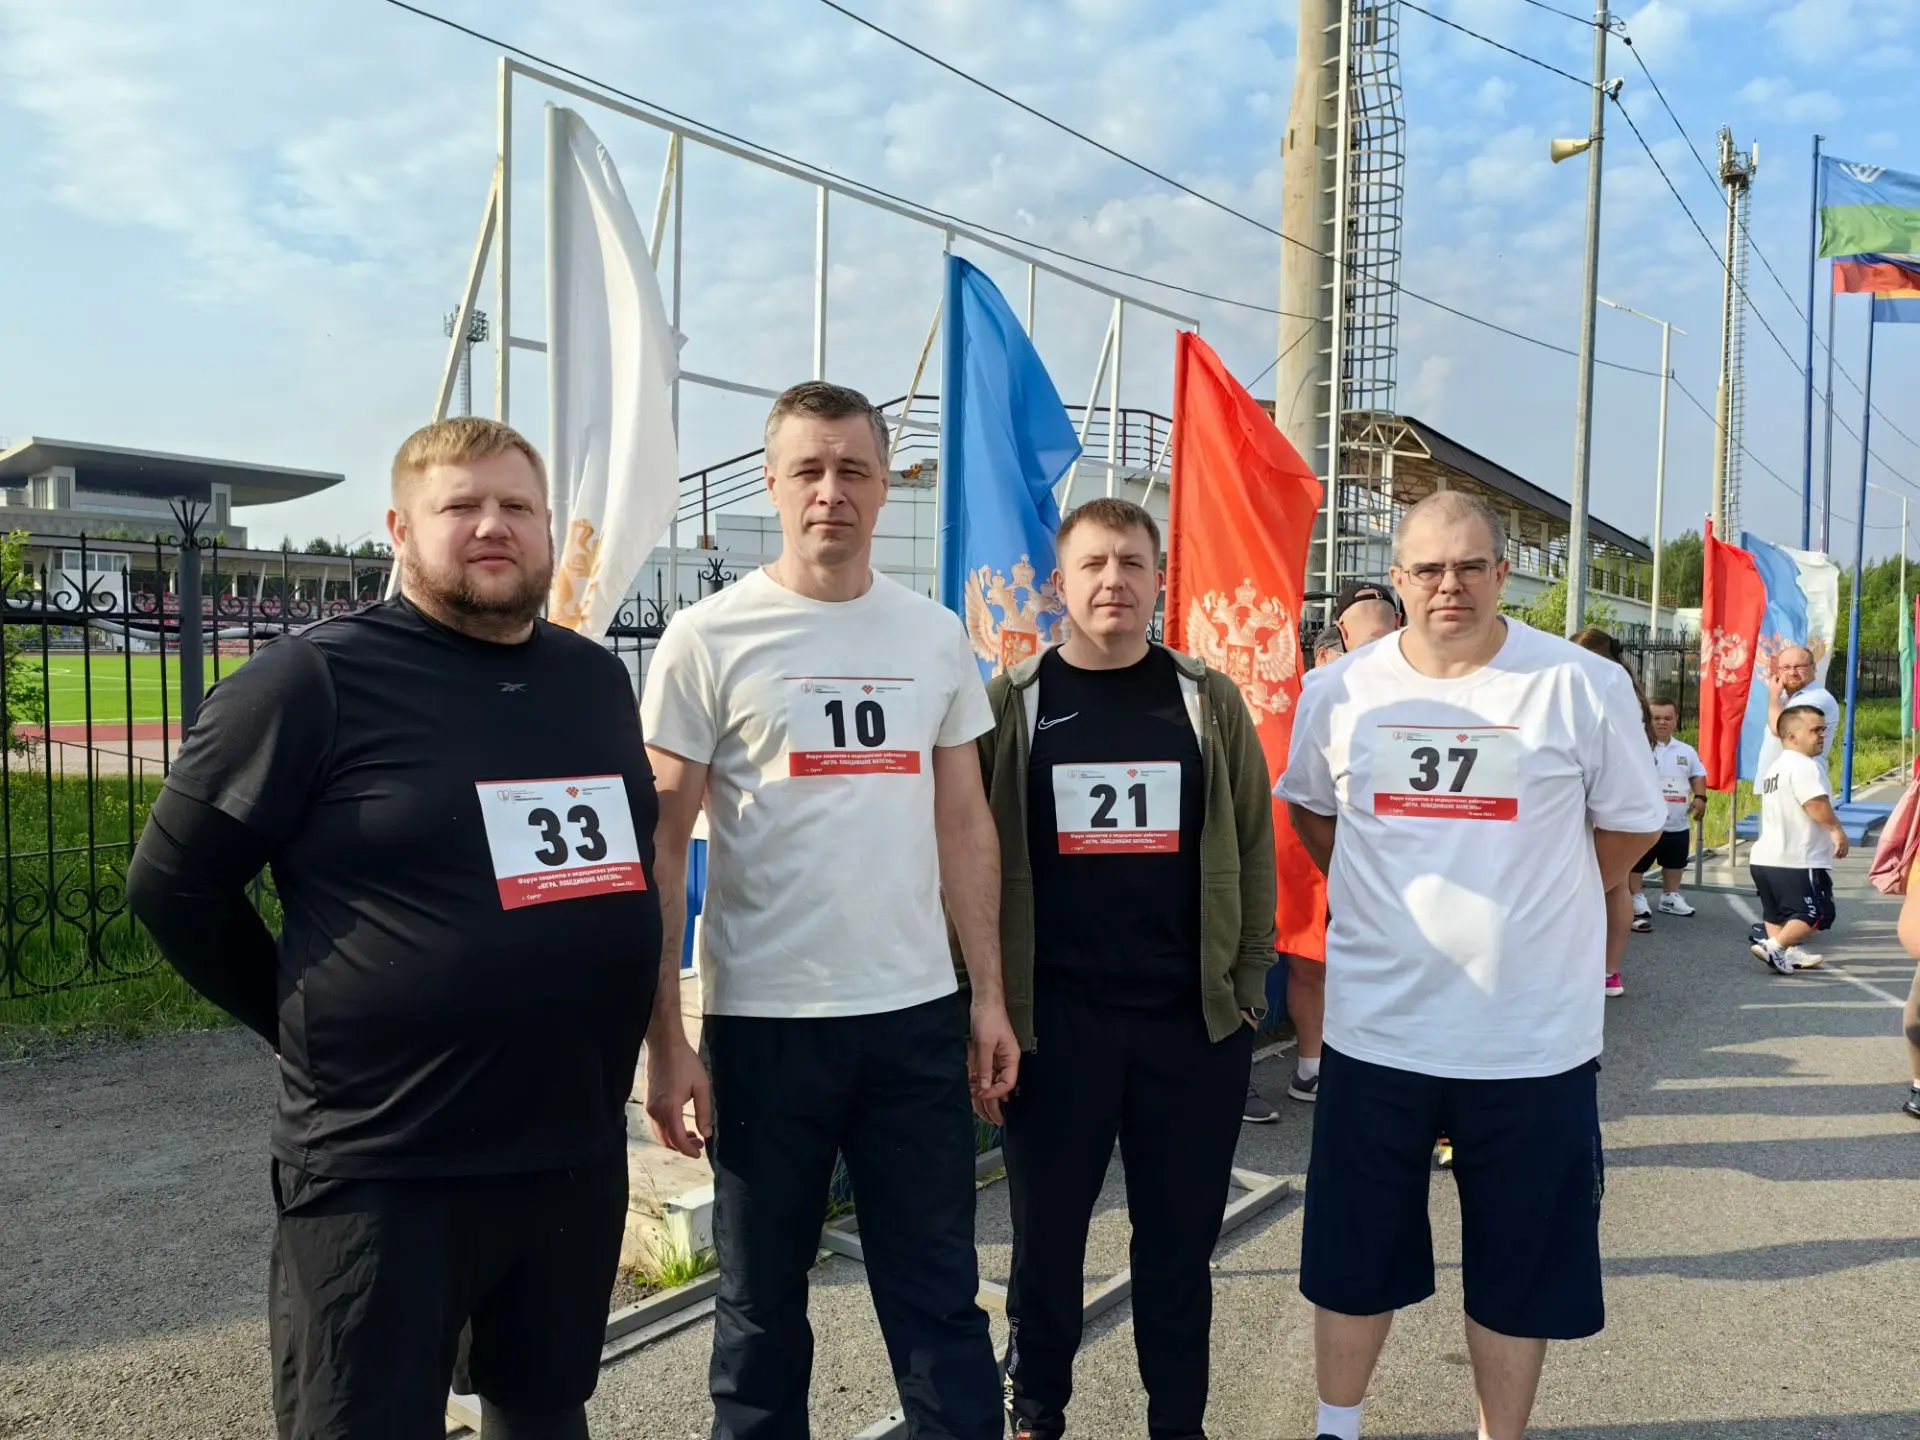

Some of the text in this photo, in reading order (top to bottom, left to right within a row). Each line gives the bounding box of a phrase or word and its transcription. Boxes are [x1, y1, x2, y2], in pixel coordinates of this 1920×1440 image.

[824, 699, 886, 748] 10
[1408, 746, 1479, 793] 37
[1089, 782, 1148, 828] 21
[527, 804, 608, 867] 33
